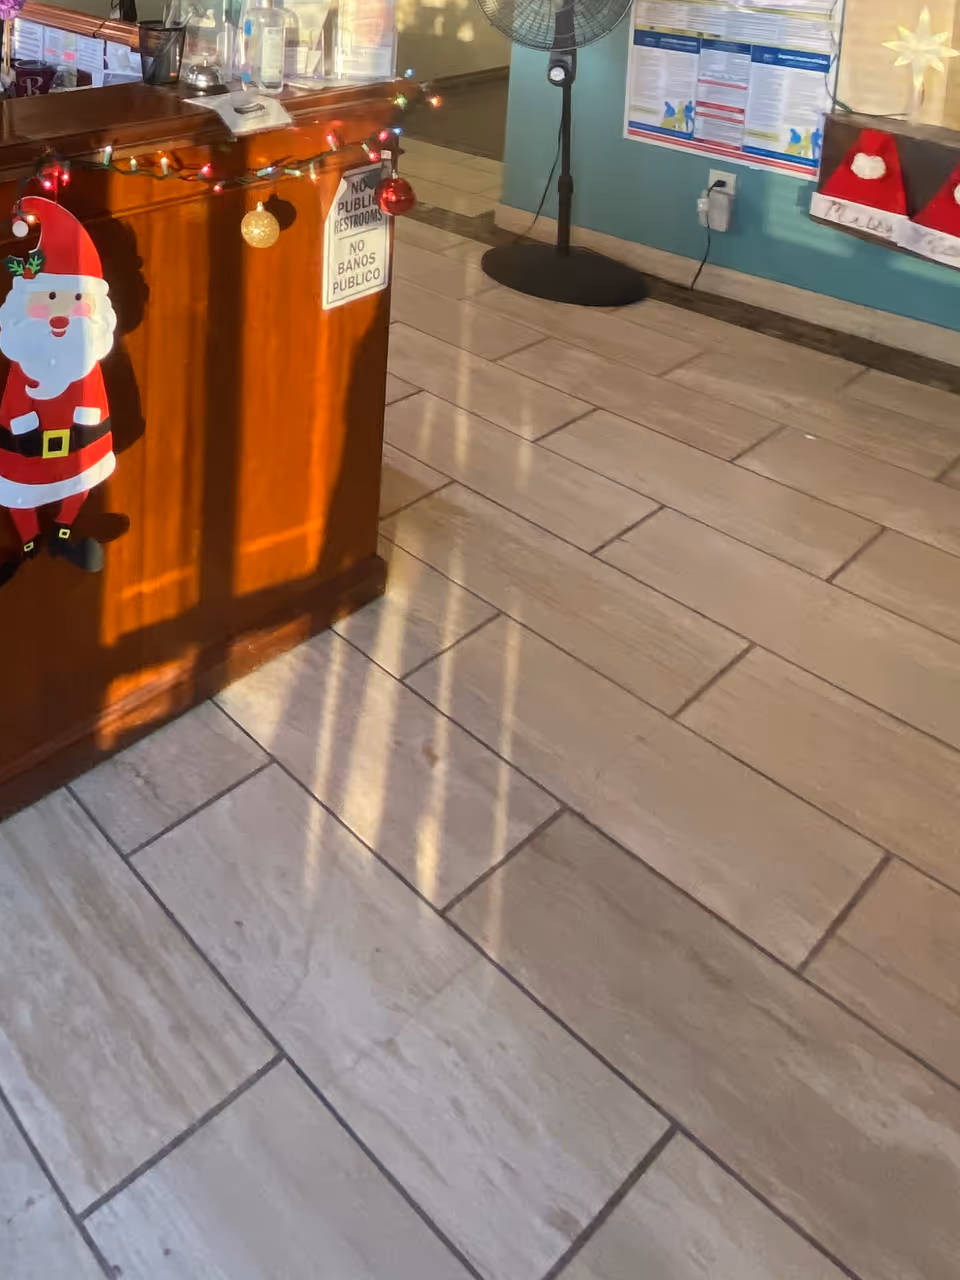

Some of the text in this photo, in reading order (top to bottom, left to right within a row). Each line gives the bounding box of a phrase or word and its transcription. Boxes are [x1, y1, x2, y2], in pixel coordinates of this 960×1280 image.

[351, 177, 367, 195] NO
[334, 208, 383, 235] RESTROOMS
[349, 239, 365, 256] NO
[337, 252, 376, 275] BAÑOS
[332, 267, 381, 295] PUBLICO
